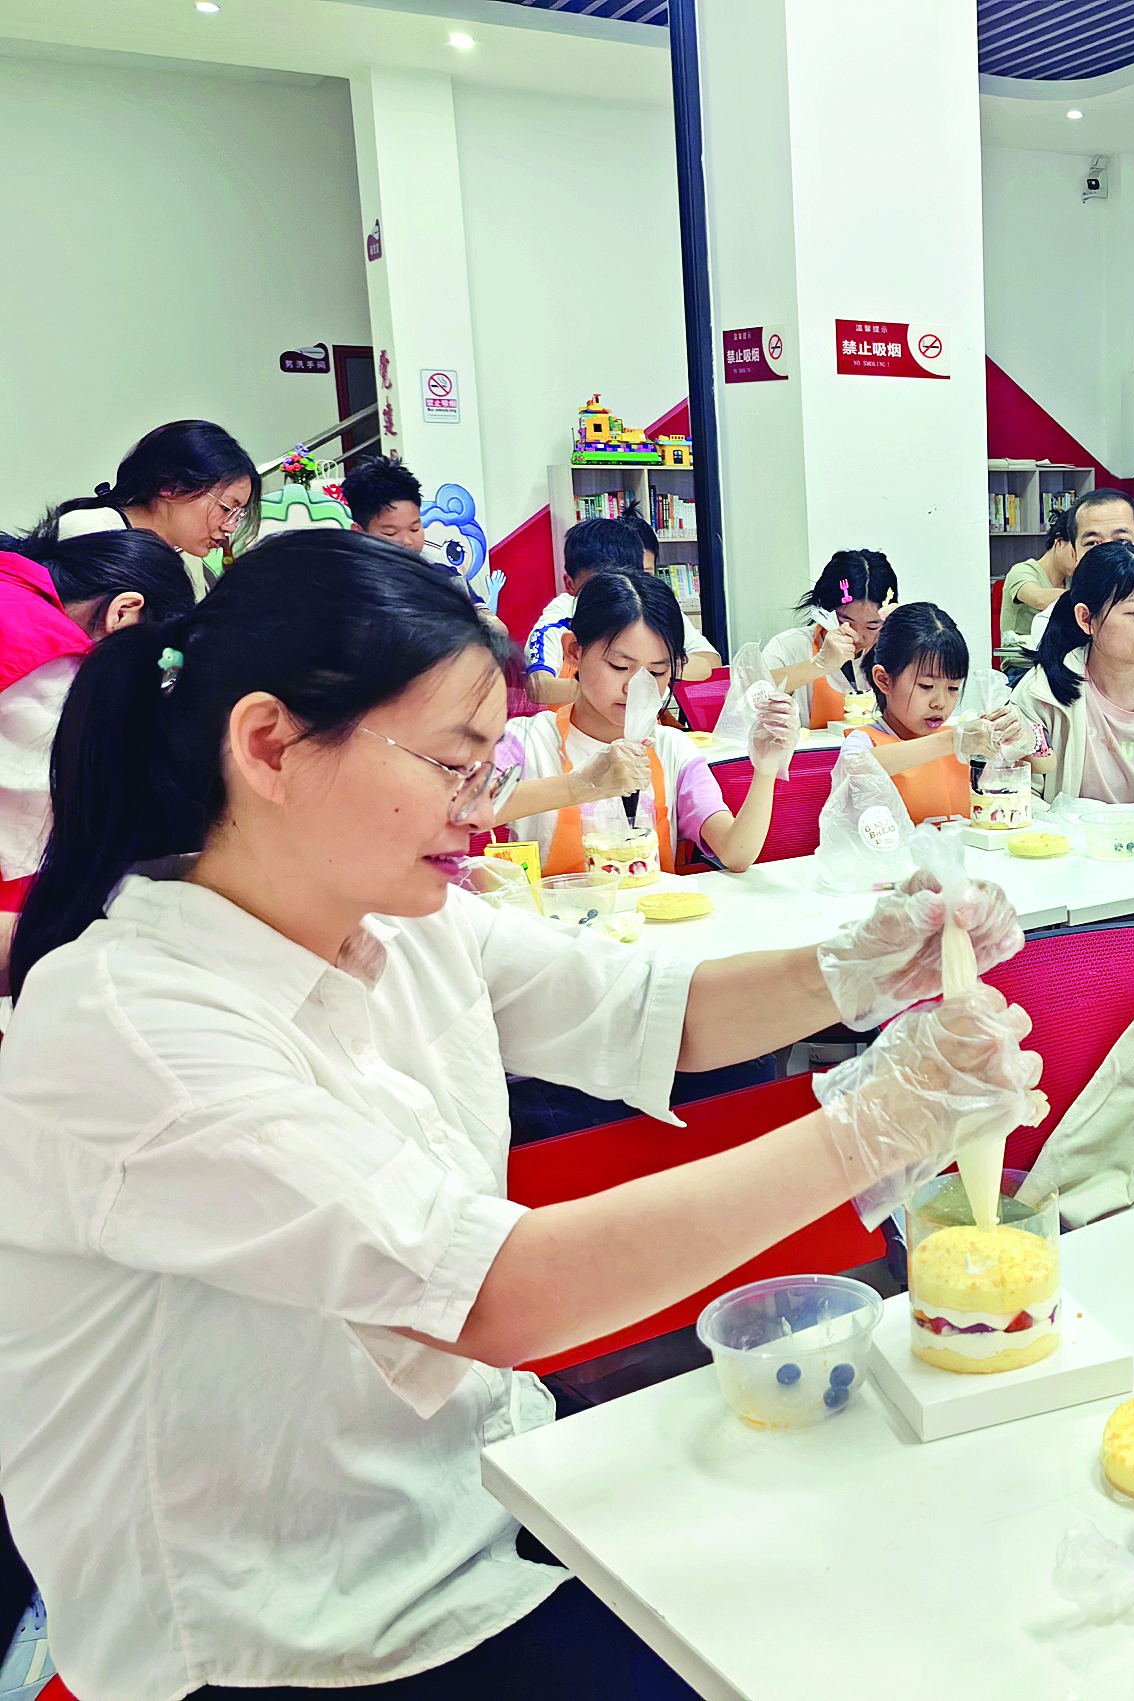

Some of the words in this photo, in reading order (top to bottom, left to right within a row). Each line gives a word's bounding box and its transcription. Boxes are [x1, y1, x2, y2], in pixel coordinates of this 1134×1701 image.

[855, 324, 888, 333] 温馨提示
[727, 347, 759, 364] 禁止吸烟
[842, 340, 901, 358] 禁止吸烟
